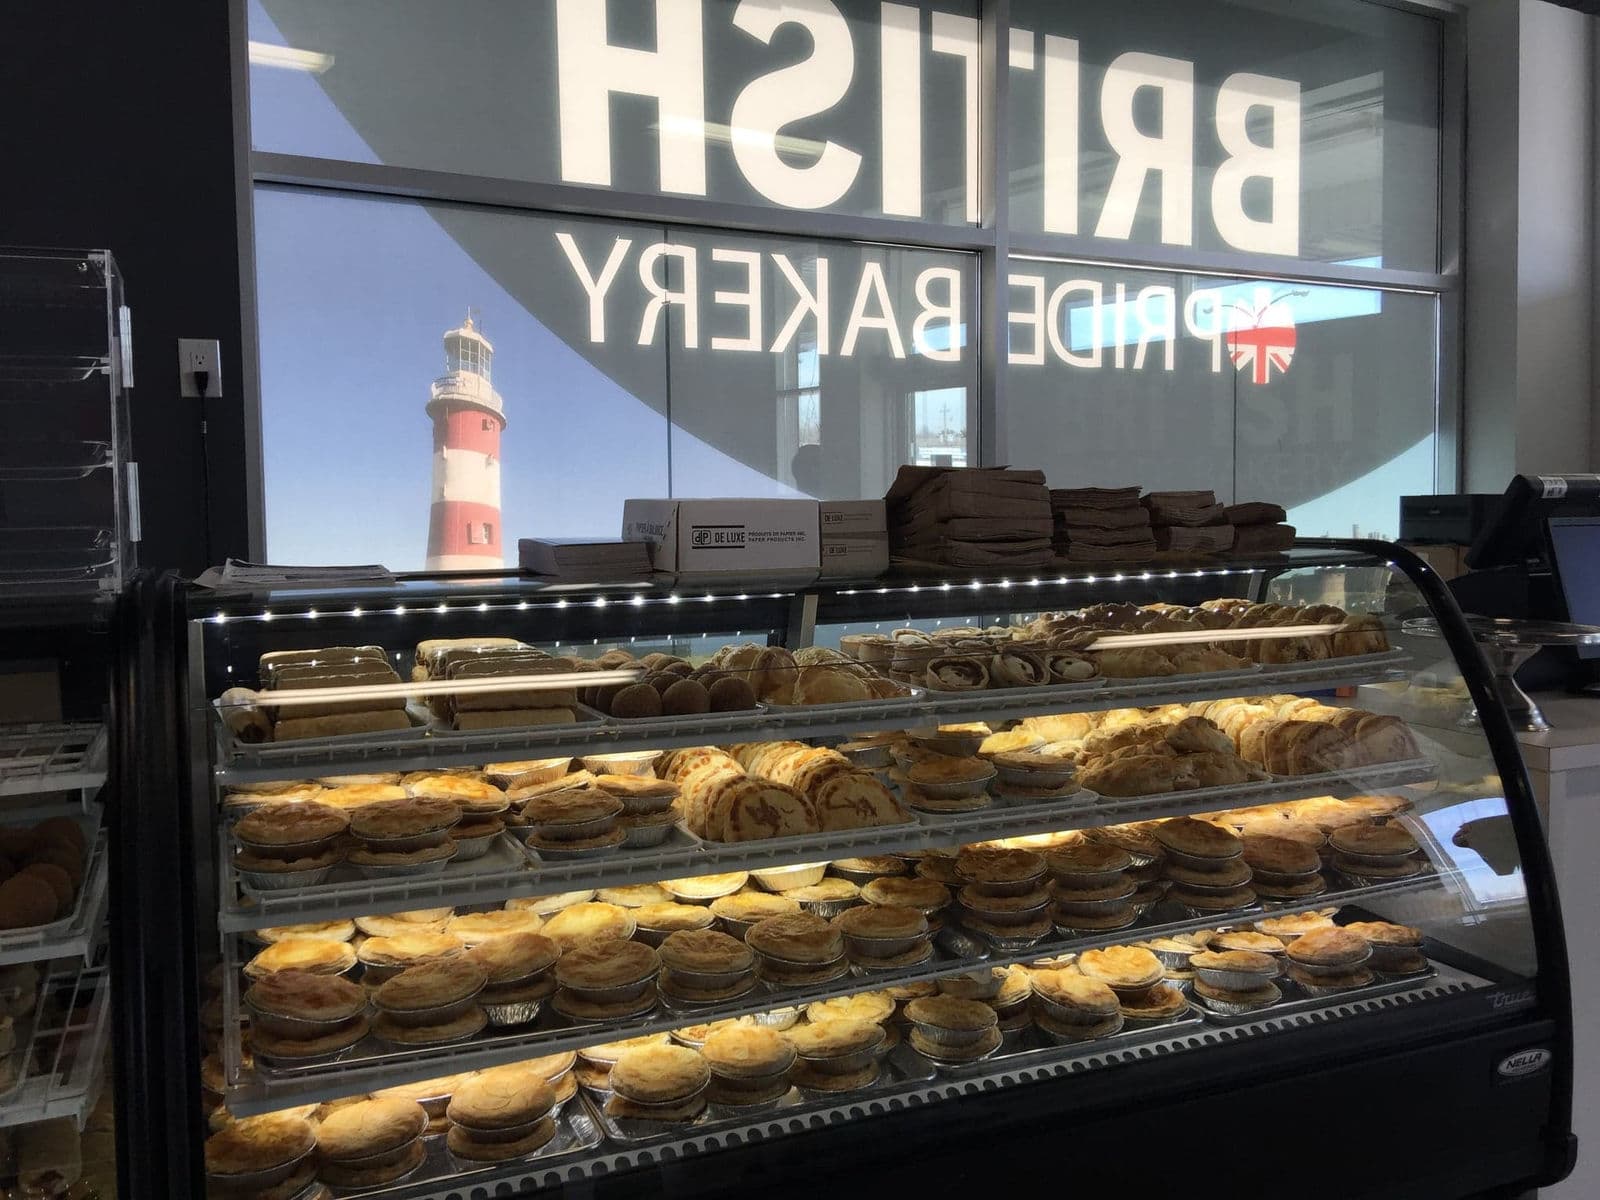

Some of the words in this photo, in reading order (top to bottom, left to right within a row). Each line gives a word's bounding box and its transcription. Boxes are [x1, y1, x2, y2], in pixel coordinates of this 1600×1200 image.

[714, 531, 725, 544] DE
[725, 531, 746, 544] LUXE
[1506, 1053, 1543, 1069] NELLA
